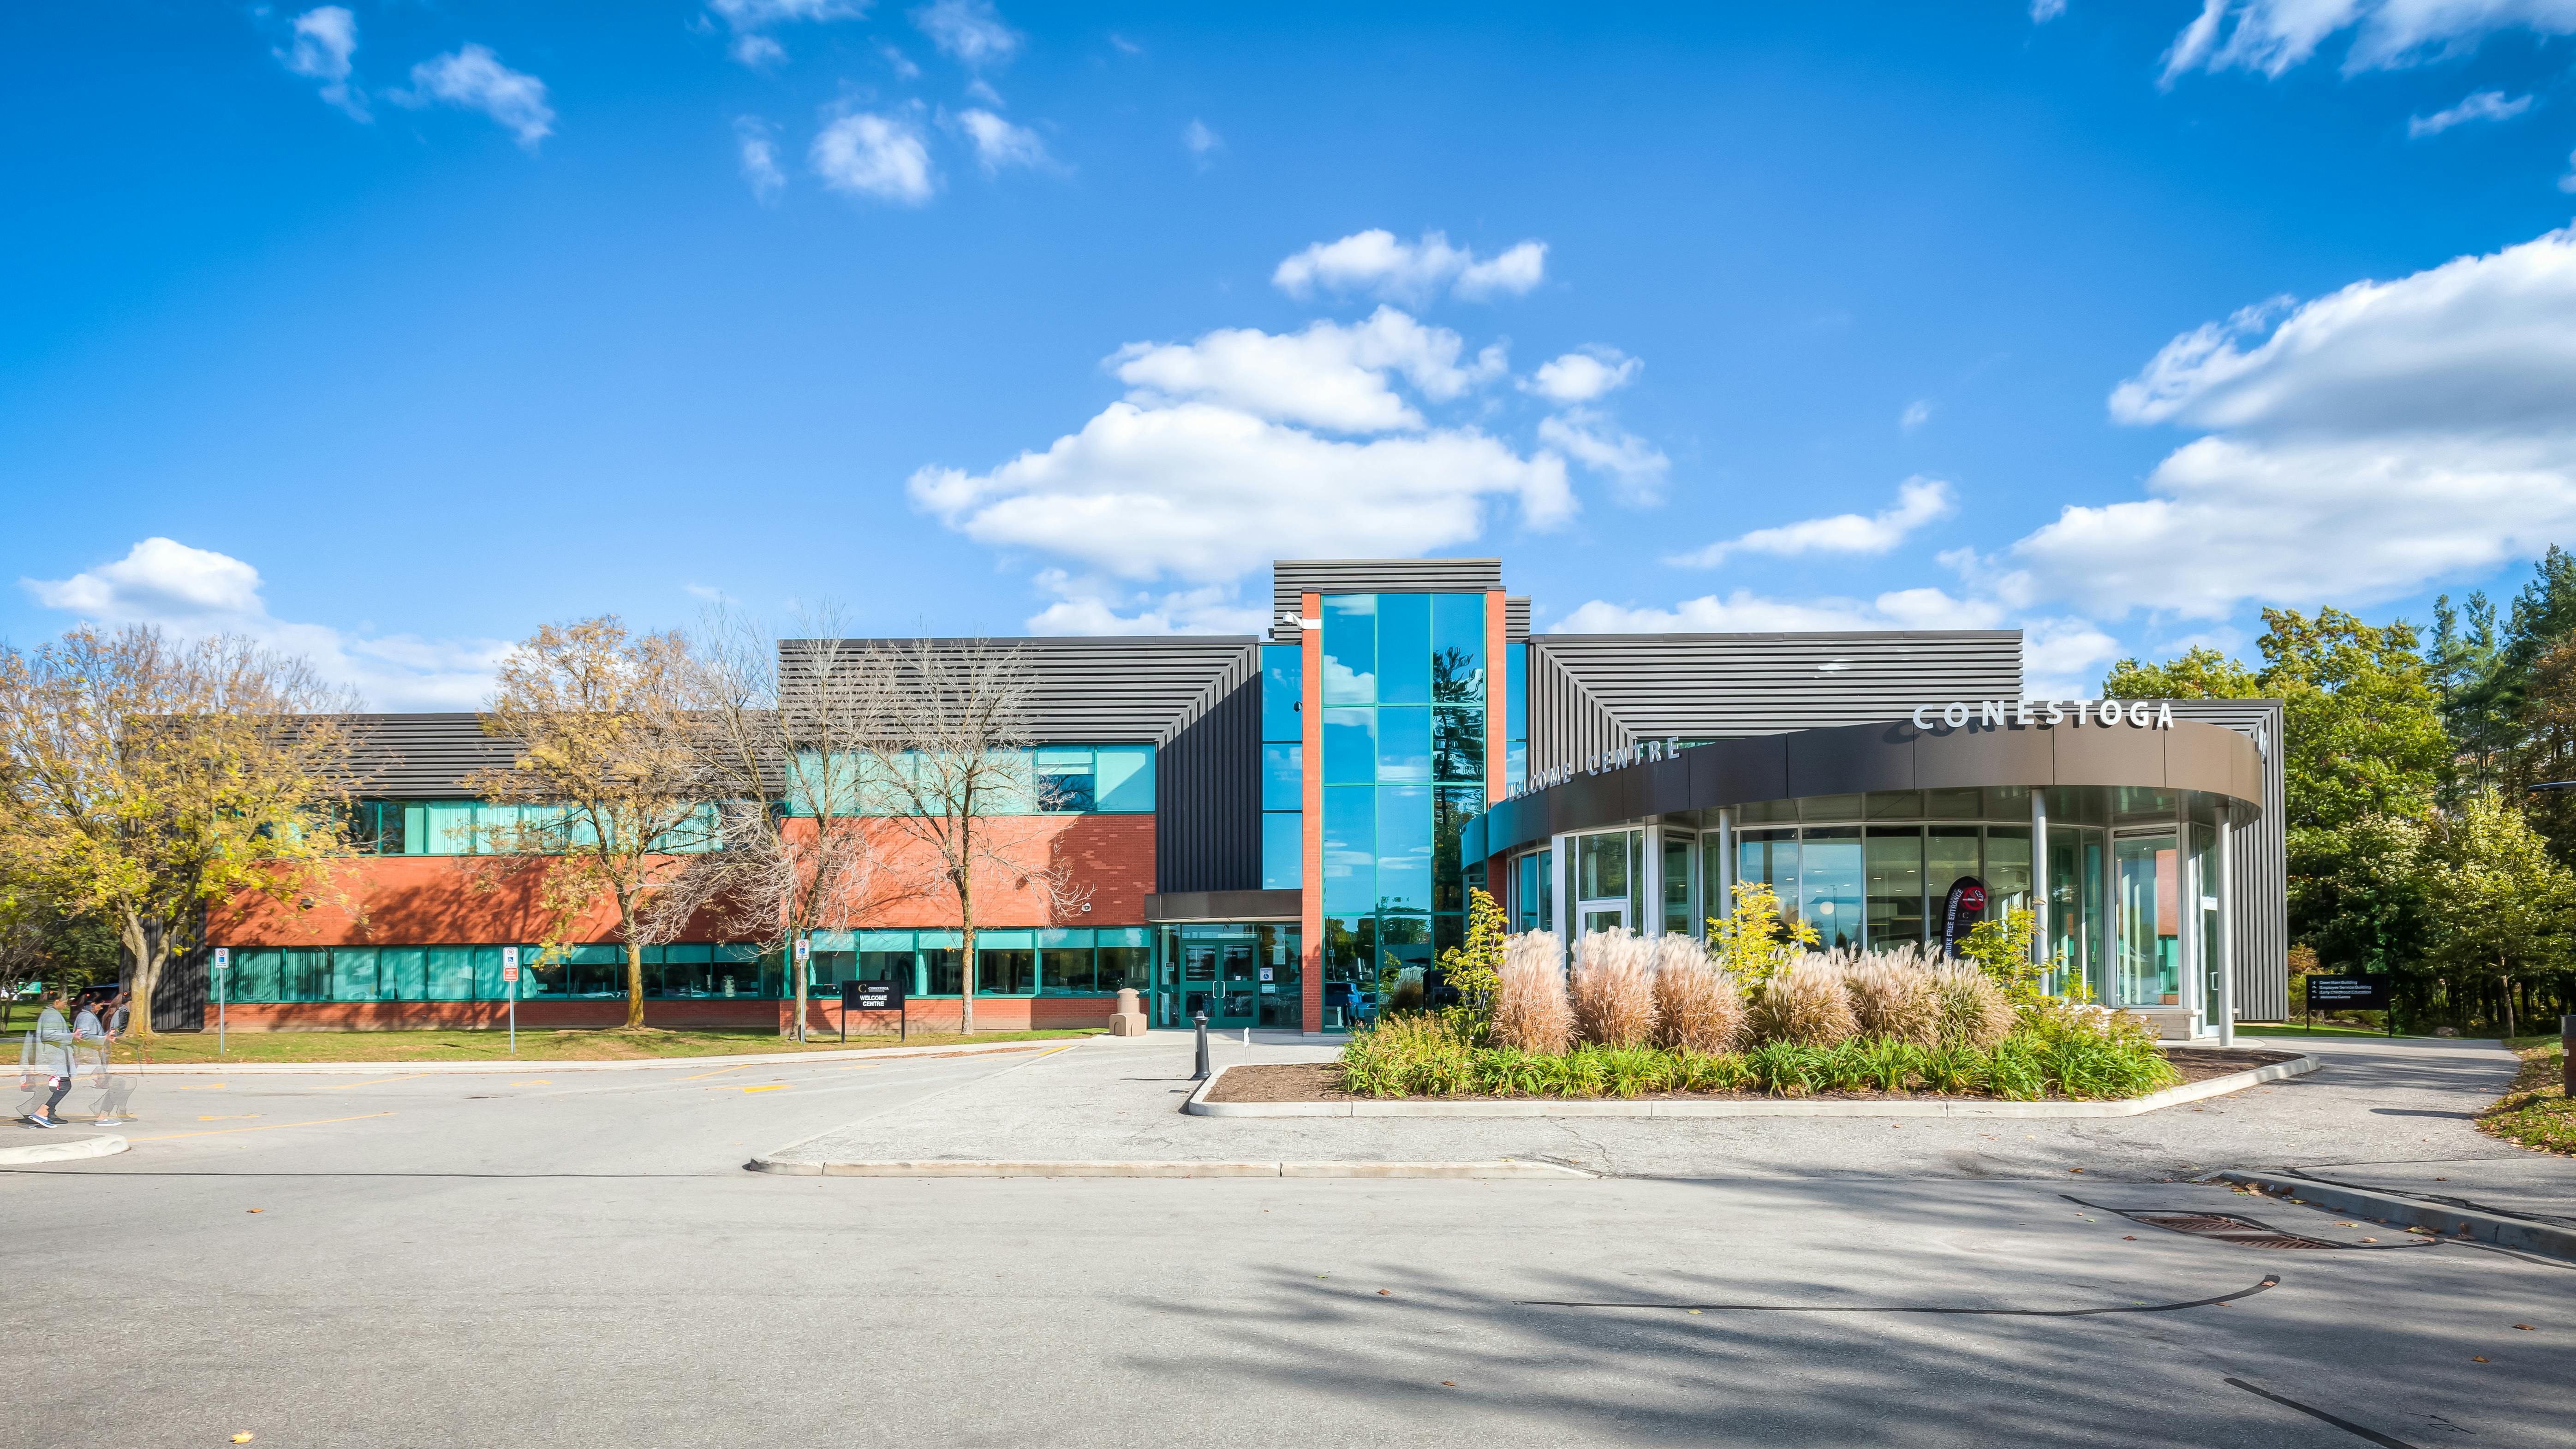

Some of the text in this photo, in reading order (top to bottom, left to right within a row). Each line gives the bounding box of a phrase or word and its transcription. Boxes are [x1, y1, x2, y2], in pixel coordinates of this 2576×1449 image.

[1913, 700, 2174, 729] CONESTOGA
[1508, 736, 1680, 802] WELCOME CENTRE
[1949, 888, 1963, 919] ENTRANCE
